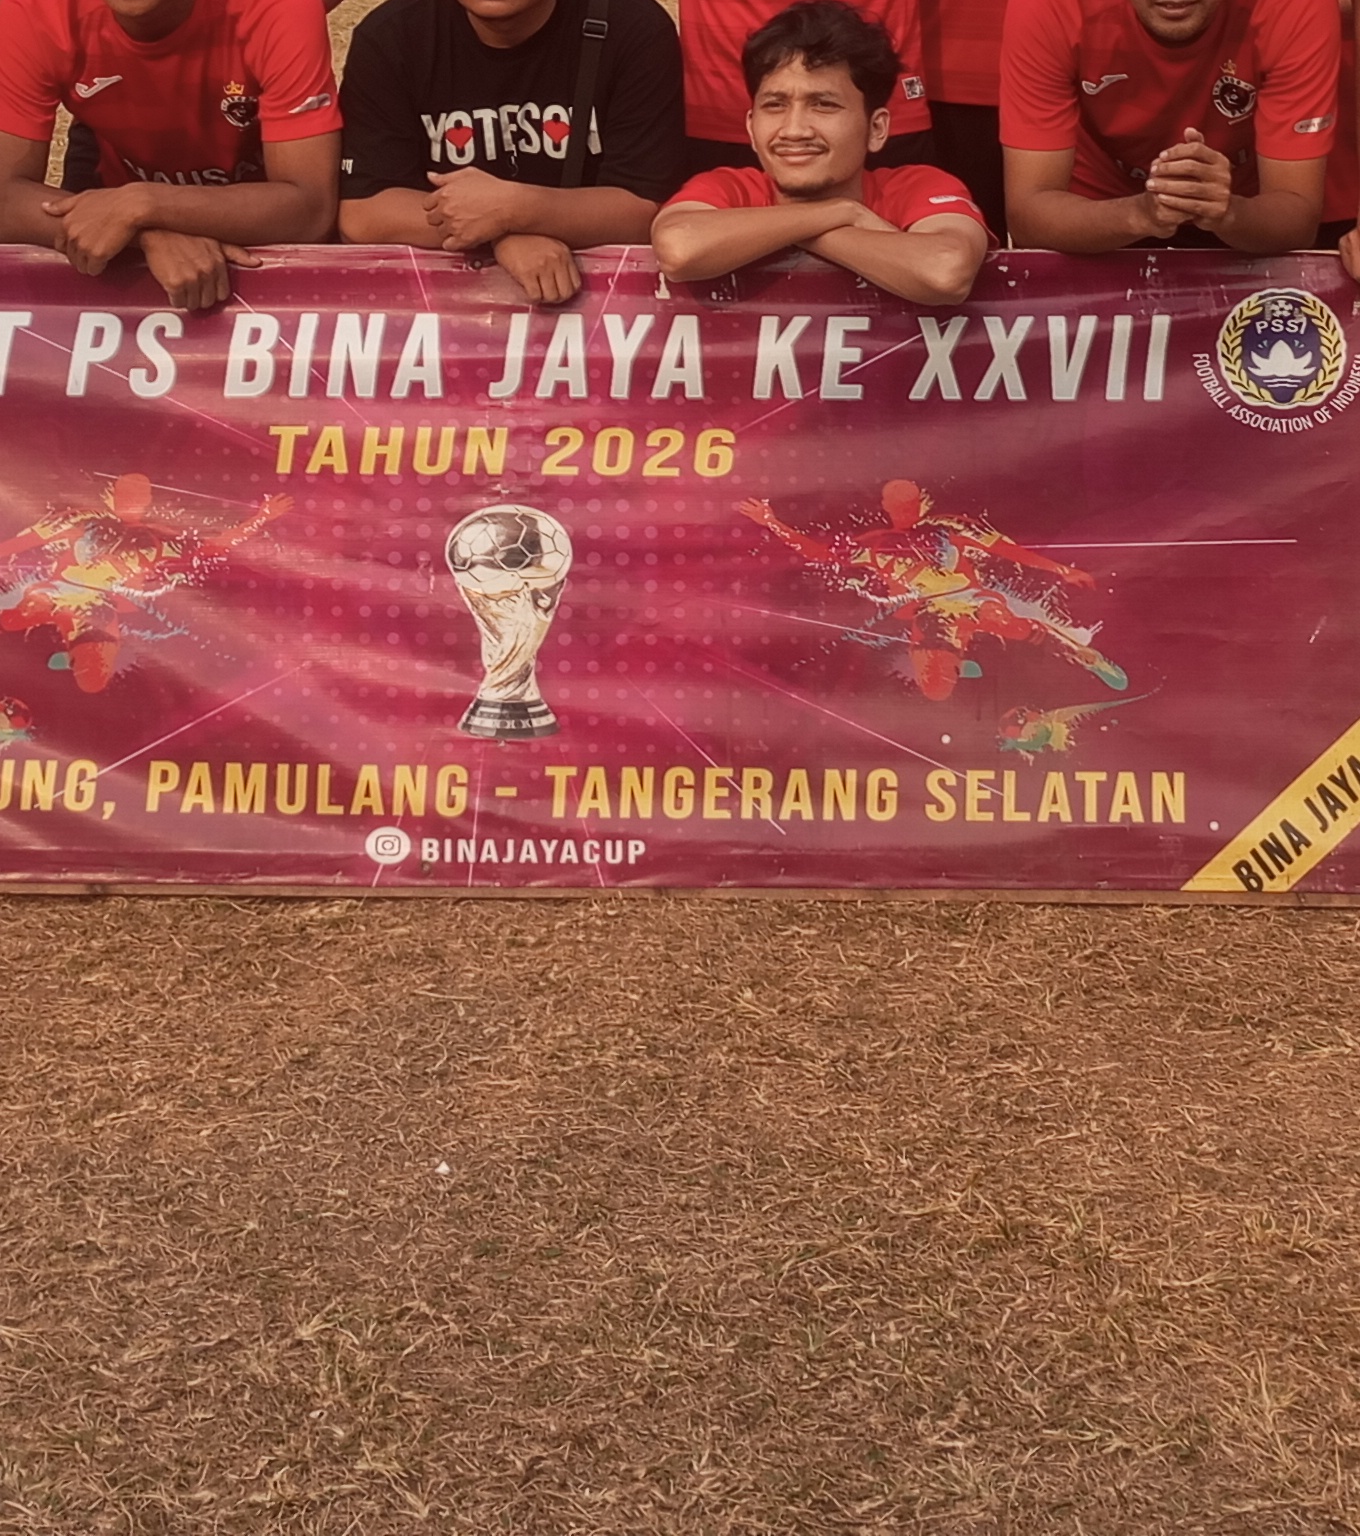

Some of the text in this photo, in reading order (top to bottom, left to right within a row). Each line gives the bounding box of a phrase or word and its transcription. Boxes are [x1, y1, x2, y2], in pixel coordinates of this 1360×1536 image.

[64, 310, 184, 400] PS
[222, 311, 444, 400] BINA
[489, 313, 705, 400] JAYA
[752, 315, 871, 401] KE
[907, 314, 1173, 402] XXVII
[1192, 352, 1232, 409] FOOTBALL
[1226, 404, 1314, 434] ASSOCIATION
[1313, 405, 1333, 424] OF
[269, 425, 736, 477] TAHUN 2026
[145, 760, 469, 819] PAMULANG
[546, 765, 899, 822] TANGERANG
[924, 768, 1186, 824] SELATAN
[421, 837, 646, 864] BINAJAYACUP
[1231, 818, 1312, 892] BINA
